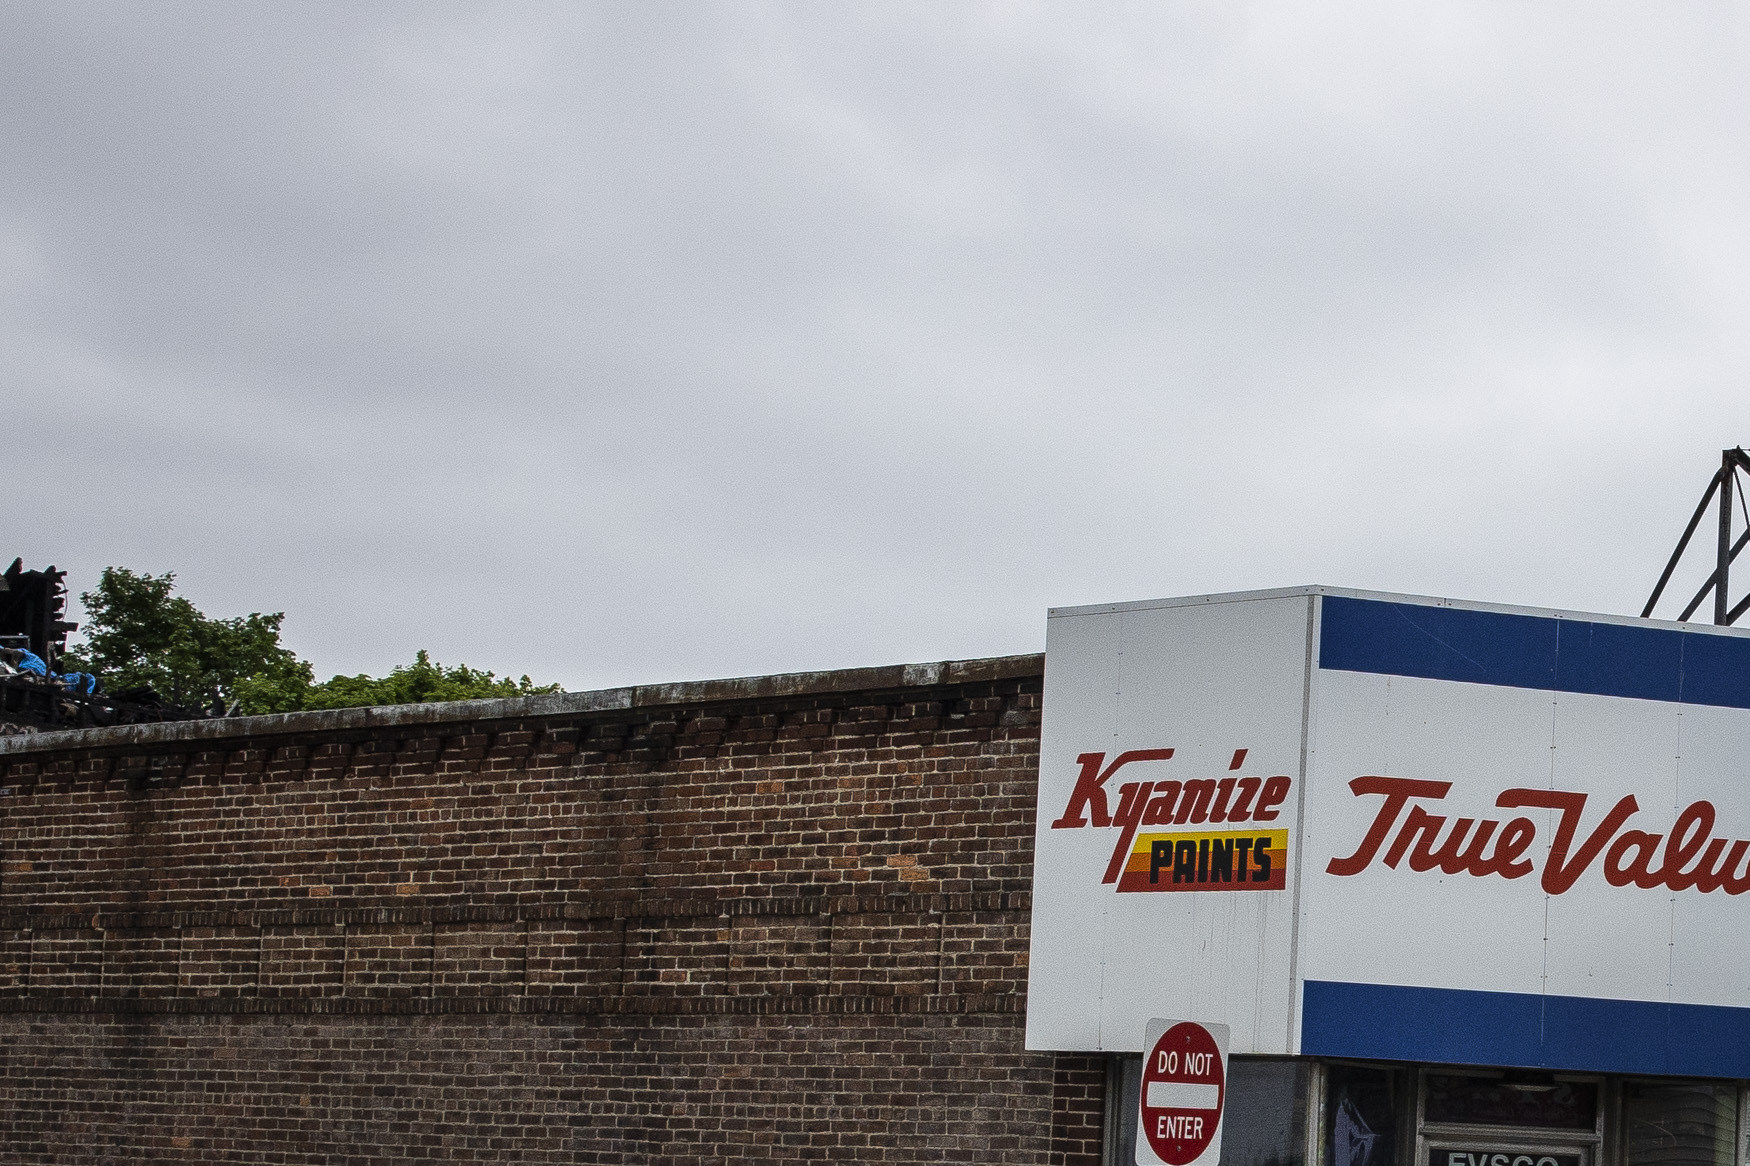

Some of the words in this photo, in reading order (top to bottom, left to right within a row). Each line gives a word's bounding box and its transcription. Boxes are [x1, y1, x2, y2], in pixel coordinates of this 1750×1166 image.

[1051, 748, 1292, 884] Kyanize
[1149, 837, 1272, 884] PAINTS
[1158, 1051, 1178, 1074] DO
[1184, 1052, 1213, 1076] NOT
[1157, 1116, 1203, 1139] ENTER
